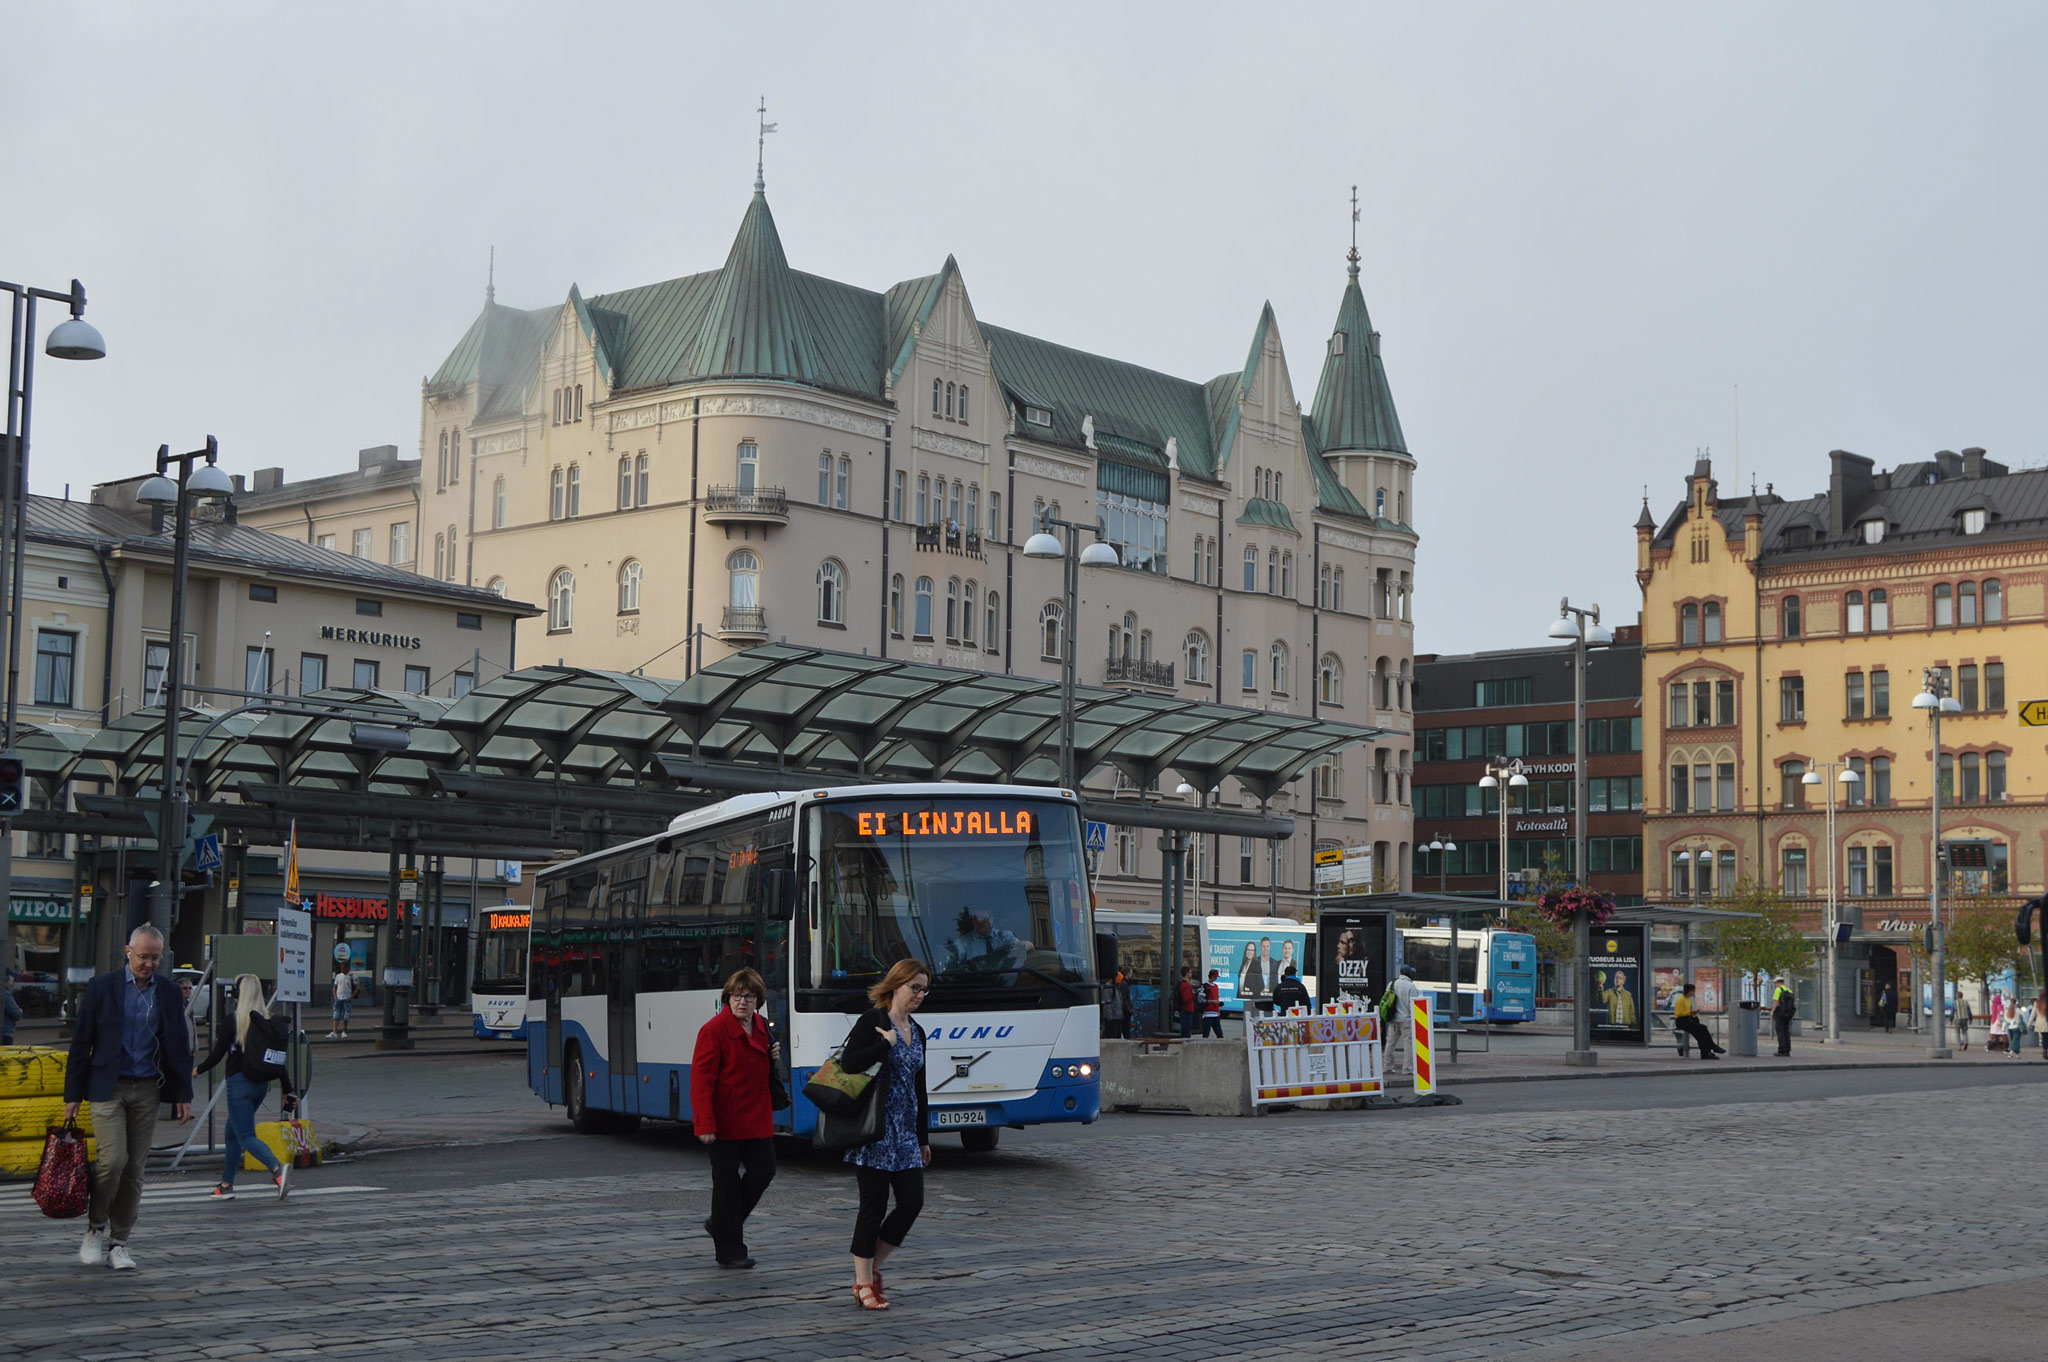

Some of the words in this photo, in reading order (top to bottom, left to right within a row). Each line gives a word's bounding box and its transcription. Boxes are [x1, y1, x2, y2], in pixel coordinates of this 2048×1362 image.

[320, 625, 421, 650] MERKURIUS
[1532, 764, 1547, 774] YH
[768, 805, 793, 822] PAUNU
[858, 812, 887, 836] EI
[902, 811, 1031, 835] LINJALLA
[1515, 819, 1568, 832] Kotosalla
[316, 892, 405, 920] HESBURGR
[490, 914, 498, 929] 10
[1338, 959, 1369, 977] OZZY
[926, 1025, 1015, 1041] AUNU
[939, 1111, 985, 1125] GIO-924
